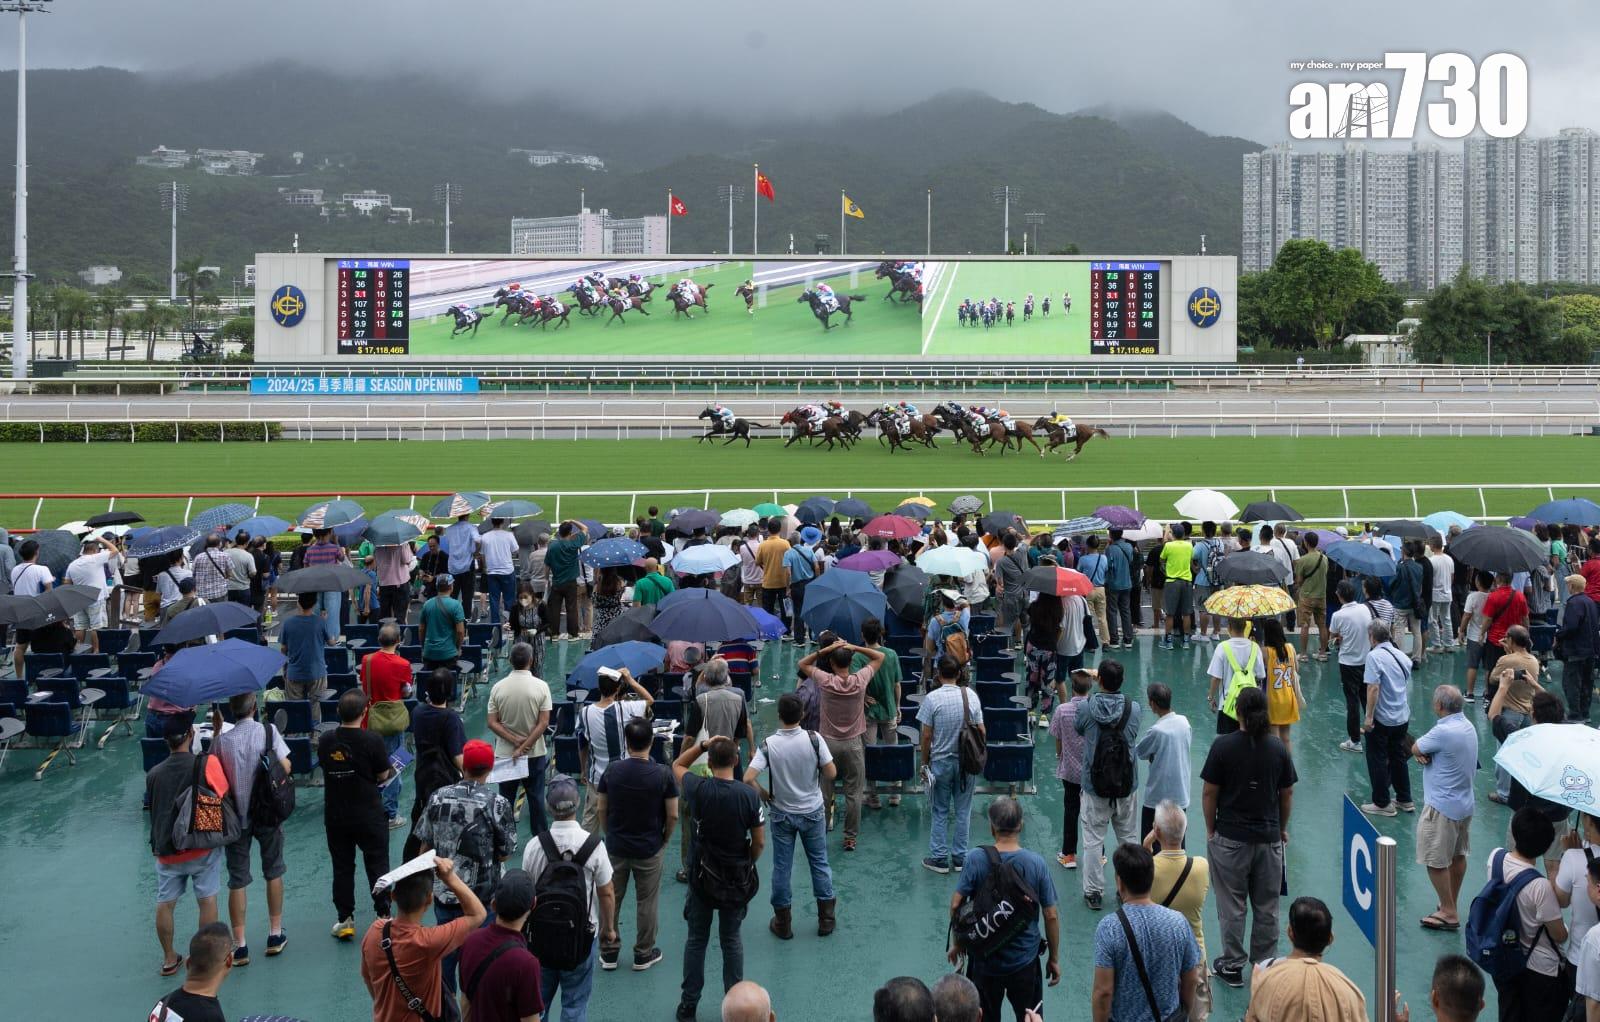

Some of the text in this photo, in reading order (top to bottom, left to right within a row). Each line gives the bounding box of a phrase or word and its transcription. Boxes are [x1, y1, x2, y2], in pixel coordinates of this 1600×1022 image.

[268, 378, 314, 392] 2024/25
[370, 379, 412, 392] SEASON
[416, 379, 462, 392] OPENING
[1273, 666, 1292, 689] 24
[1351, 833, 1372, 910] C
